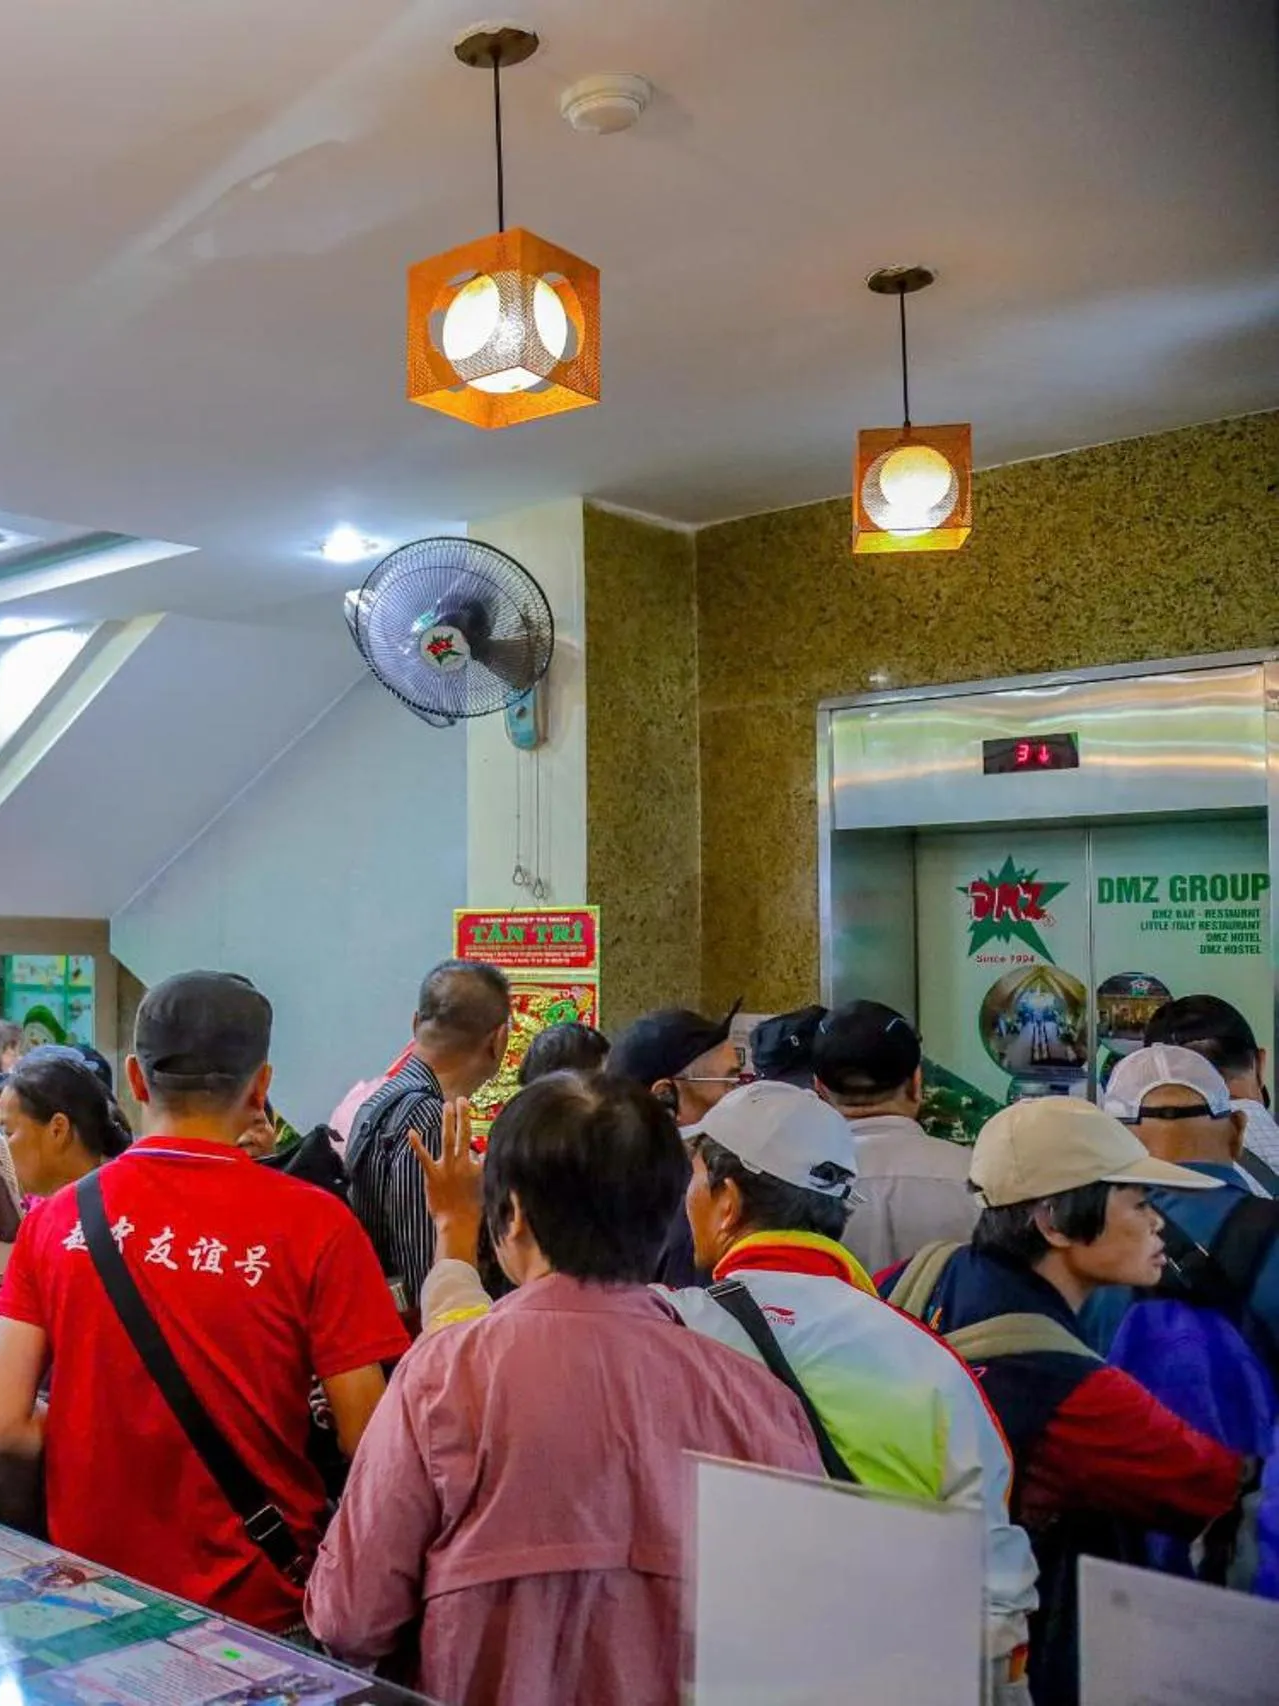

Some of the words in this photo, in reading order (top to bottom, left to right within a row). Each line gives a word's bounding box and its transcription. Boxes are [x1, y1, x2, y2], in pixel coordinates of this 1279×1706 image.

[1016, 743, 1030, 762] 3
[1096, 876, 1160, 904] DMZ
[1169, 873, 1271, 903] GROUP
[968, 880, 1050, 922] DMZ
[1231, 932, 1262, 942] HOTEL
[1223, 945, 1262, 955] HOSTEL
